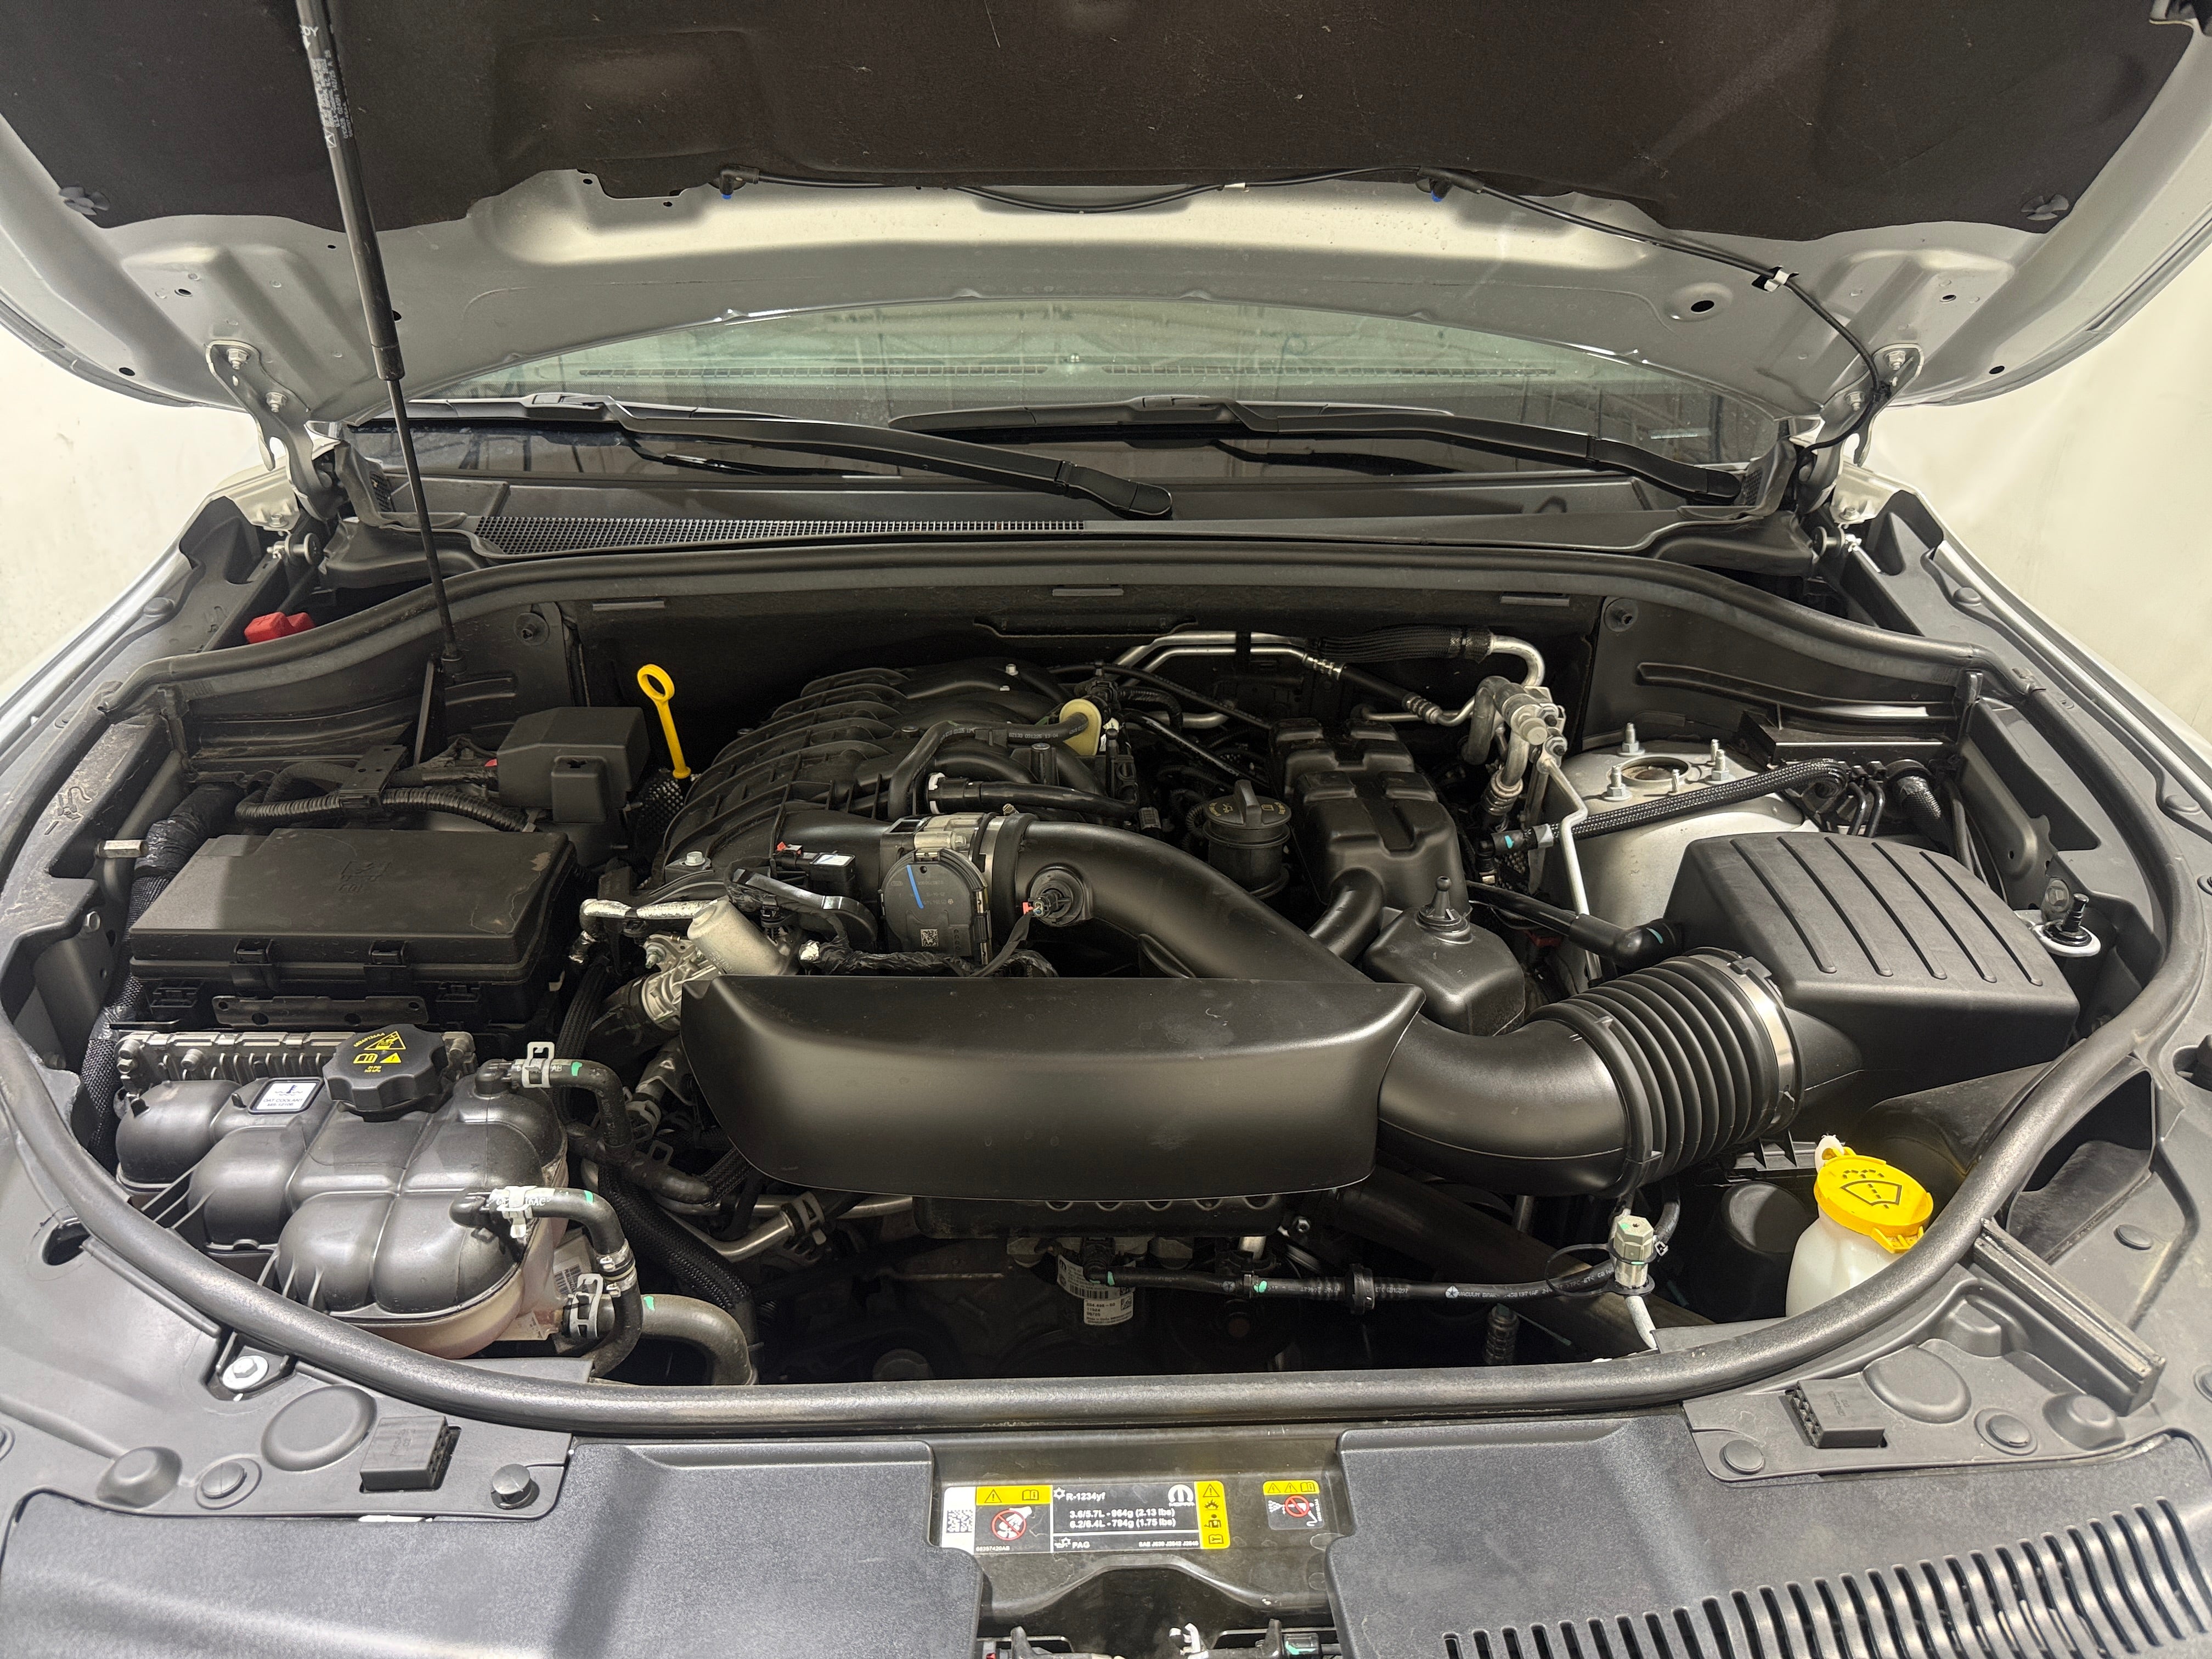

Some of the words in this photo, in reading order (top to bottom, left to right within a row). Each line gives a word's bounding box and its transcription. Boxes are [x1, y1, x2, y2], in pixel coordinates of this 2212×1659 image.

[1066, 1492, 1106, 1502] R-1234yf
[1069, 1509, 1105, 1519] 3.6/5.7L
[1135, 1508, 1157, 1517] (2.13
[1158, 1508, 1175, 1517] lbs)
[1069, 1519, 1105, 1528] 6.2/6.4L
[1136, 1518, 1158, 1528] (1.75
[1159, 1517, 1176, 1528] lbs)
